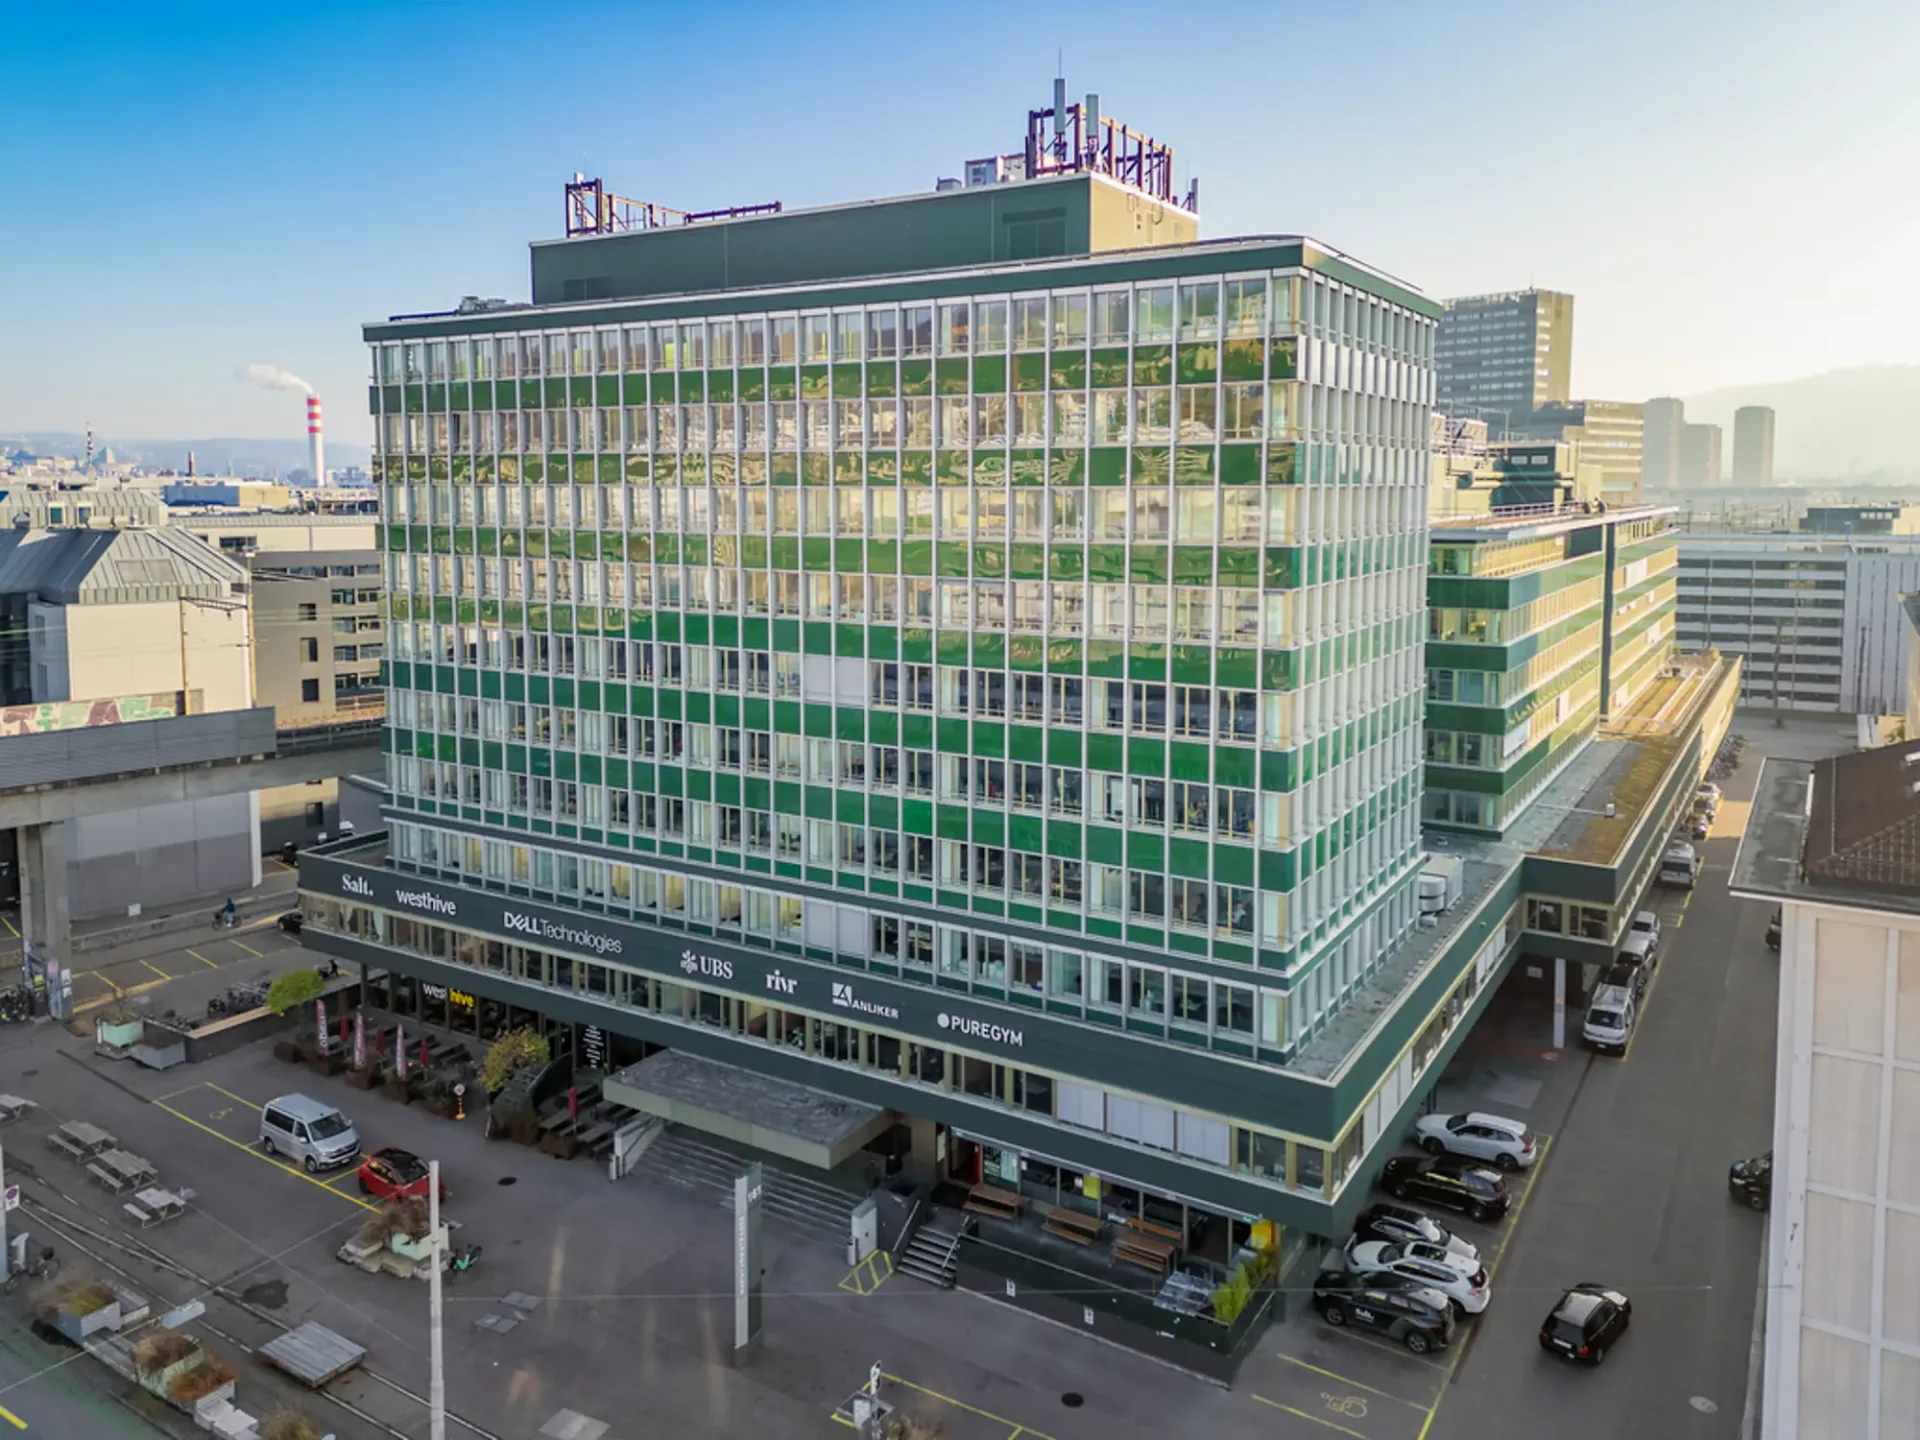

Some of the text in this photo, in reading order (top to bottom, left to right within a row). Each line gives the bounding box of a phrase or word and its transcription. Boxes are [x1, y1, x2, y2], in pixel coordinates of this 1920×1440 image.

[342, 873, 374, 896] Salt.
[395, 889, 457, 916] westhive
[540, 918, 623, 953] Technologies
[700, 955, 734, 979] UBS
[765, 969, 798, 995] rivr
[851, 999, 899, 1019] ANLIKER
[951, 1015, 1023, 1047] PUREGYM
